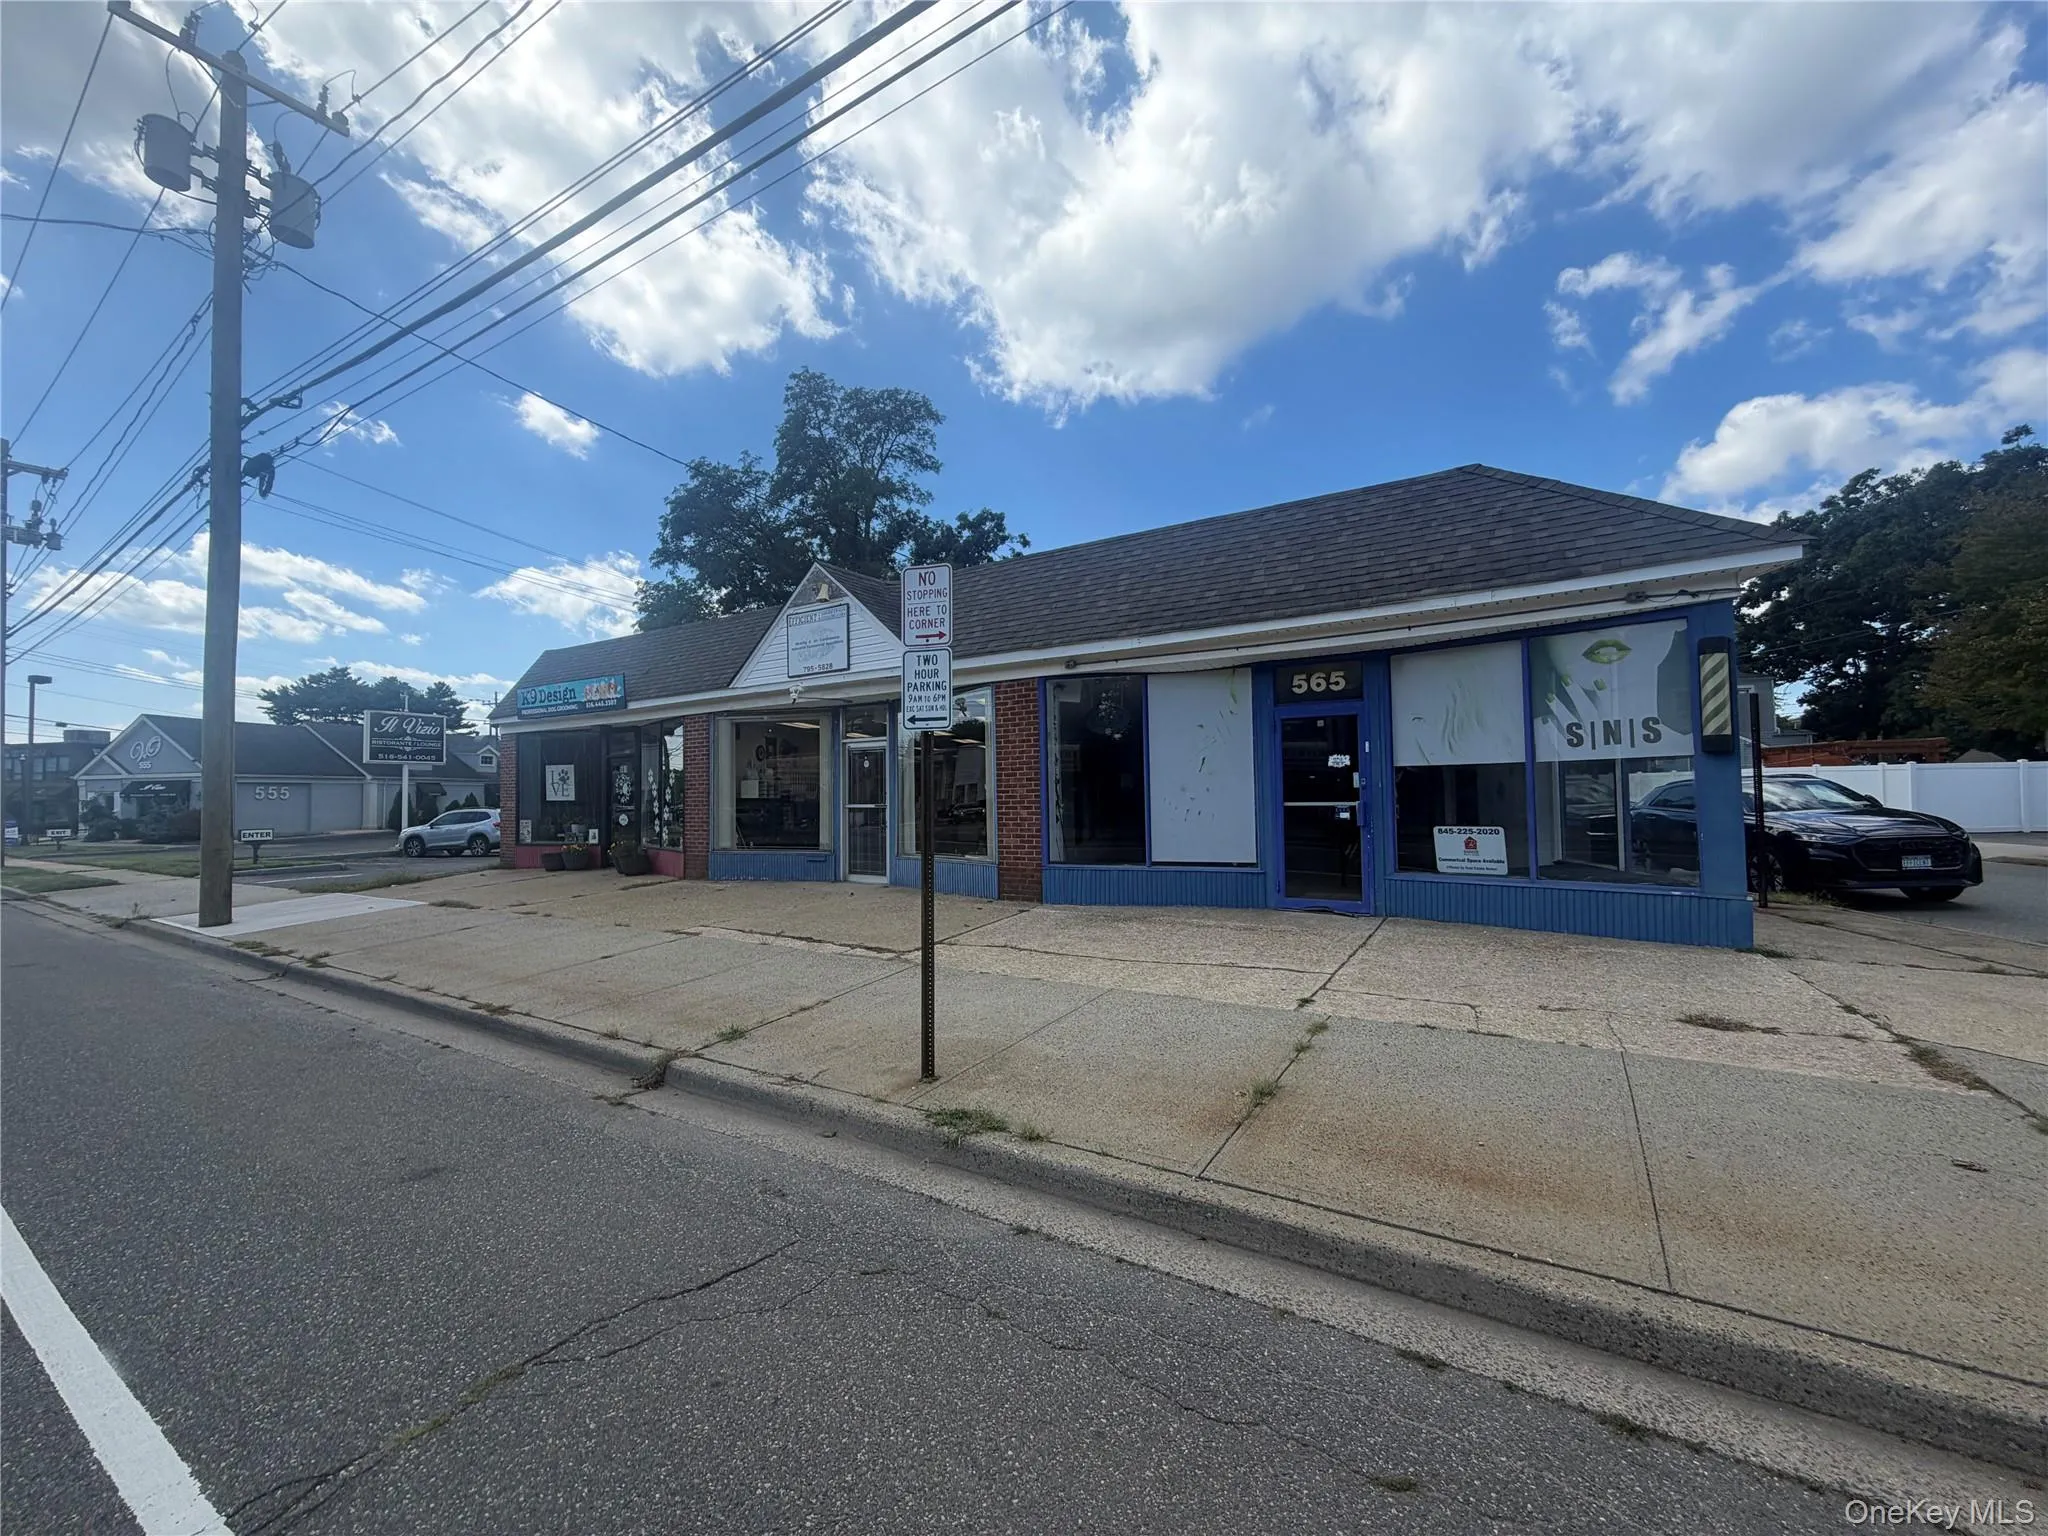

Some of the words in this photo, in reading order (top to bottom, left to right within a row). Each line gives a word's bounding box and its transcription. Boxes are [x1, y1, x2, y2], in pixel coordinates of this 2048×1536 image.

[918, 570, 936, 586] NO
[906, 588, 948, 601] STOPPING
[907, 606, 931, 617] HERE
[936, 604, 947, 616] TO
[908, 618, 945, 630] CORNER
[916, 654, 938, 666] TWO
[803, 662, 833, 672] 795-5828
[914, 668, 939, 680] HOUR
[907, 680, 947, 692] PARKING
[1291, 671, 1346, 694] 565
[521, 689, 538, 706] K9
[539, 686, 577, 704] Design
[908, 694, 922, 703] 9AM
[933, 693, 946, 702] 6PM
[374, 716, 399, 732] Il
[403, 717, 440, 735] Vizio
[255, 786, 290, 800] 555
[242, 831, 271, 839] ENTER
